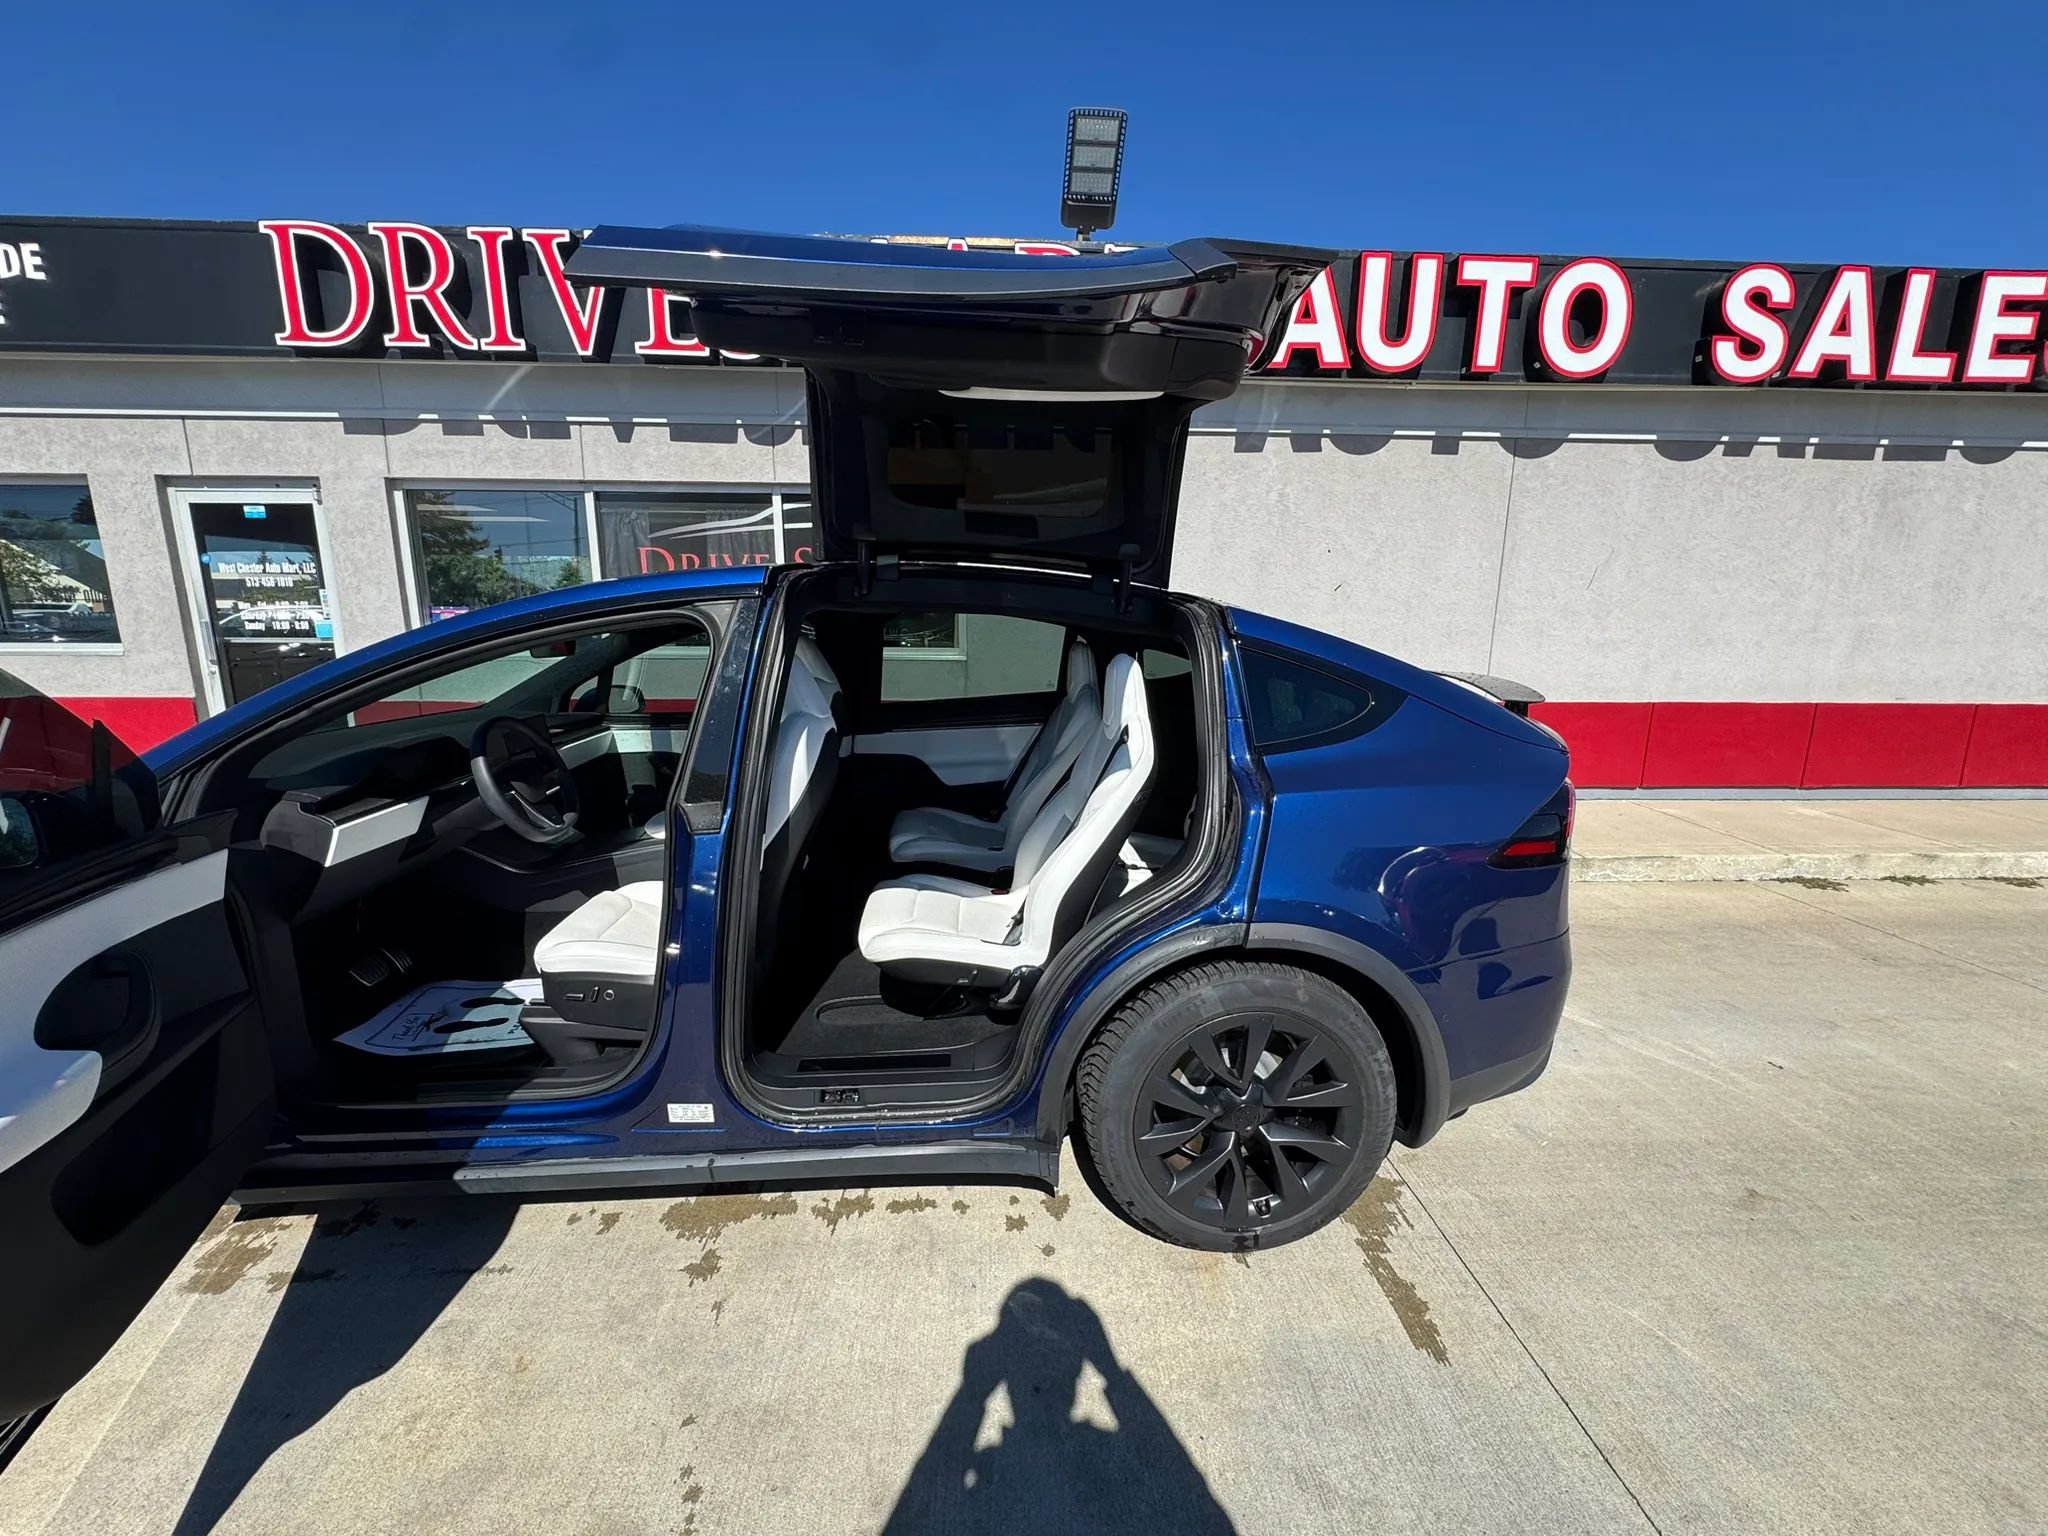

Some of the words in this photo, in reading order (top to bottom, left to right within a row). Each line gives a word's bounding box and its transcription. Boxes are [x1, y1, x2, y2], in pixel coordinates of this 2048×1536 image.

[1270, 250, 1634, 378] AUTO
[1711, 262, 2048, 384] SALE
[219, 563, 235, 573] West
[237, 562, 264, 574] Chester
[266, 563, 281, 573] Auto
[303, 564, 316, 573] LLC
